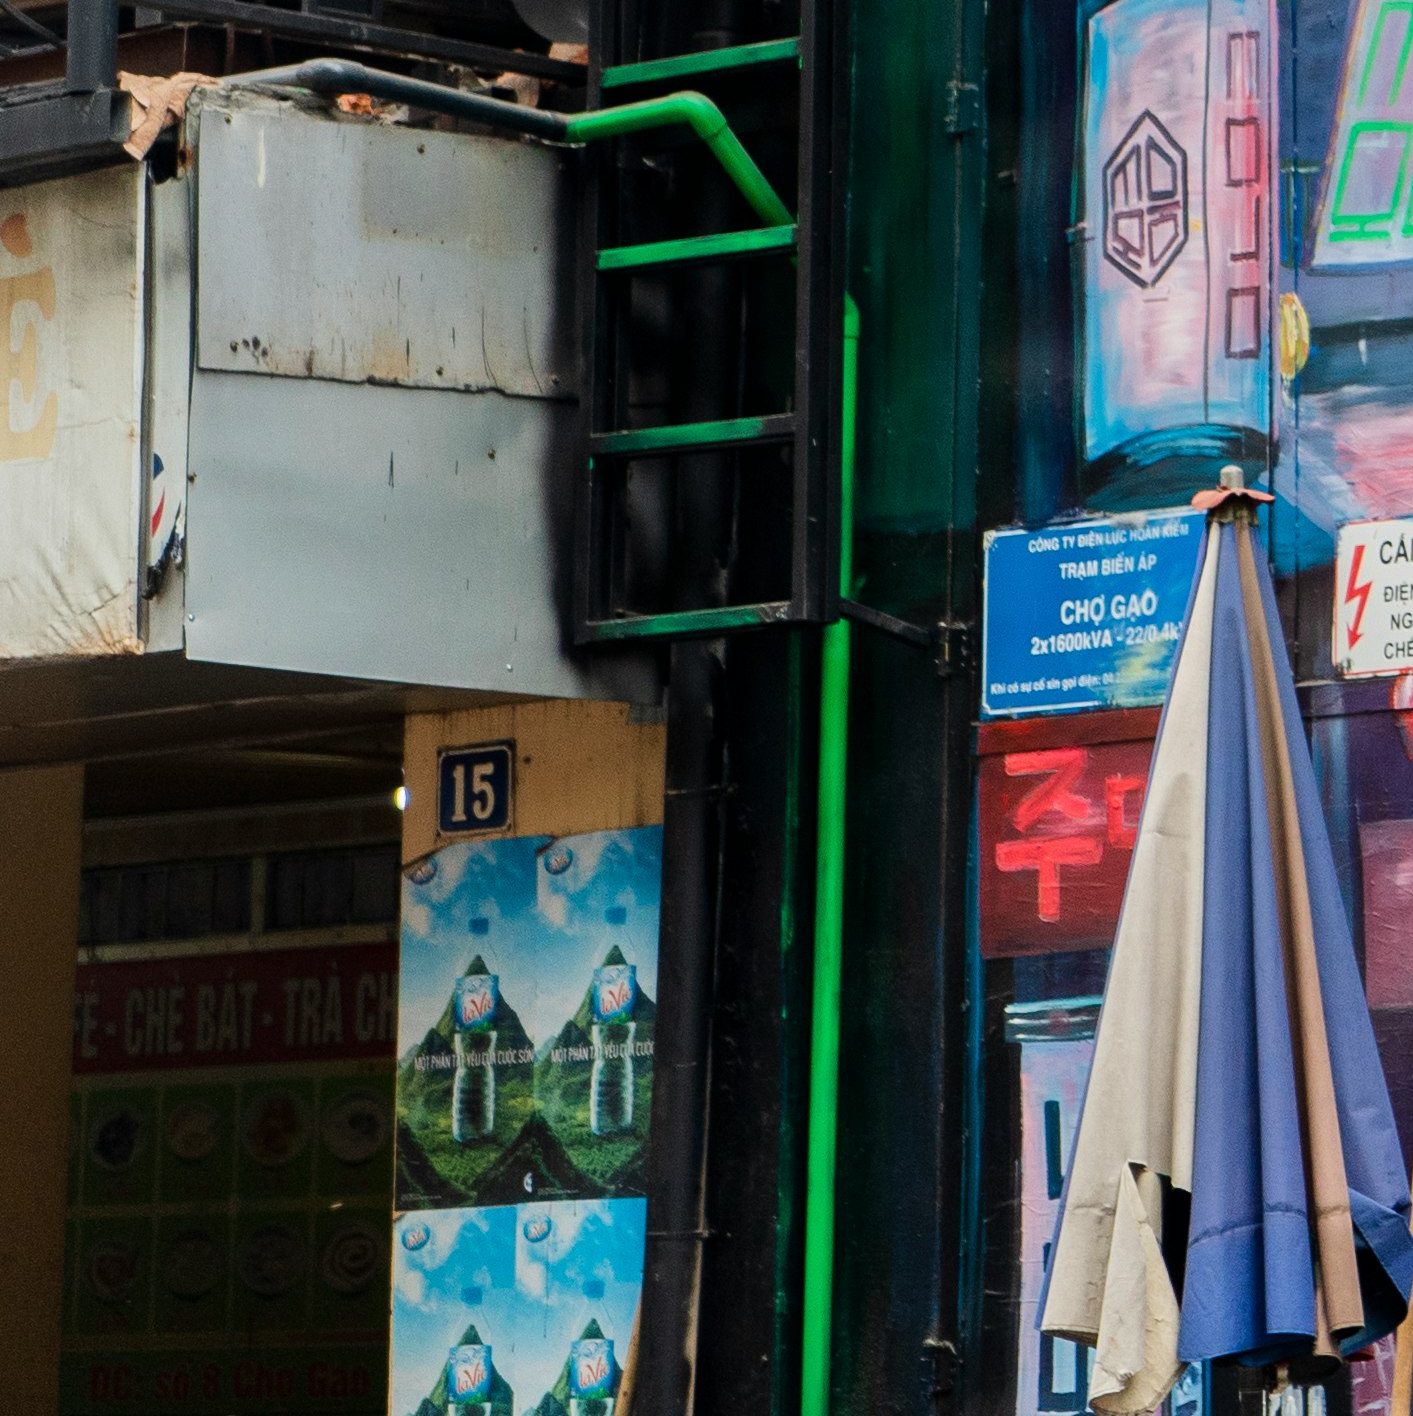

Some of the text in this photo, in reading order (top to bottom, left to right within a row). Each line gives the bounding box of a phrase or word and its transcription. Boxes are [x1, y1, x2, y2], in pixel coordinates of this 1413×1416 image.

[1062, 537, 1076, 549] TY
[1059, 561, 1098, 581] TRẠM
[1137, 552, 1158, 571] ÁP
[1060, 594, 1106, 626] CHỢ
[1030, 629, 1113, 656] 2x1600kVA
[451, 760, 496, 824] 15
